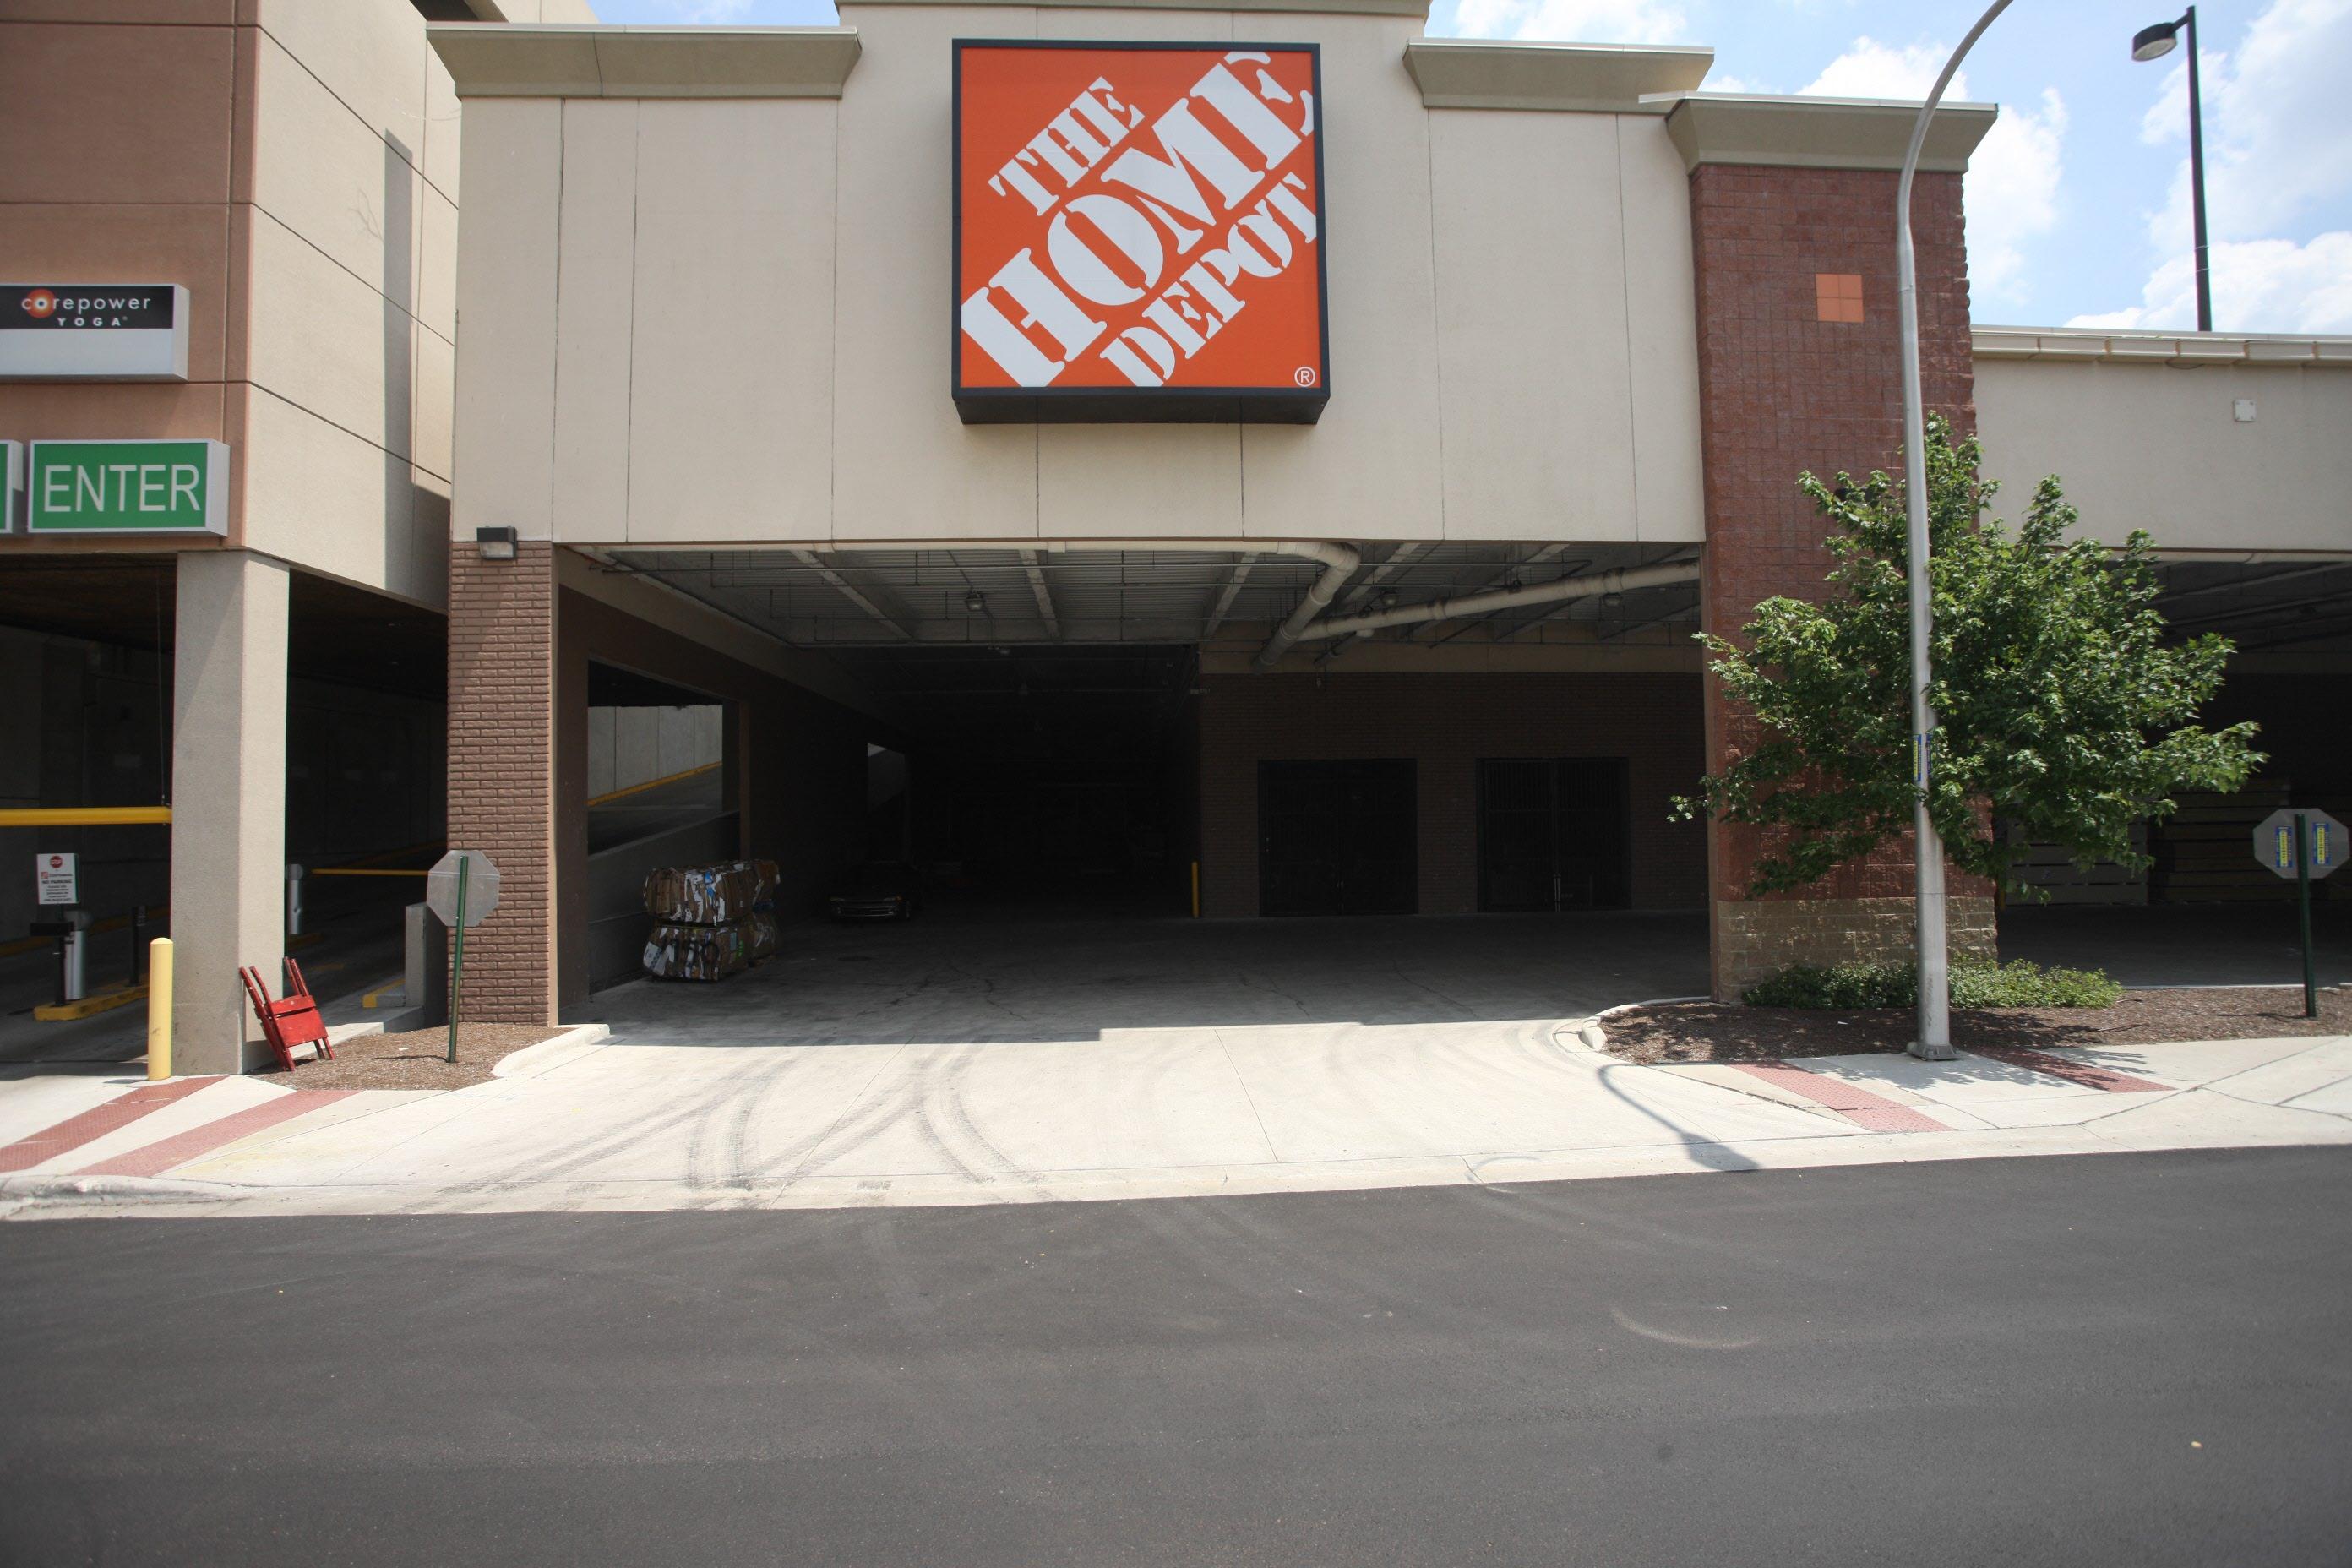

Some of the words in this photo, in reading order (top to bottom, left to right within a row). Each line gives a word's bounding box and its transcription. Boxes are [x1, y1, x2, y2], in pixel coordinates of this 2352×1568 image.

[988, 76, 1146, 216] THE
[961, 51, 1315, 388] HOME
[21, 297, 151, 315] corepower
[57, 317, 121, 327] YOGA
[1099, 172, 1317, 387] DEPOT
[44, 465, 201, 513] ENTER
